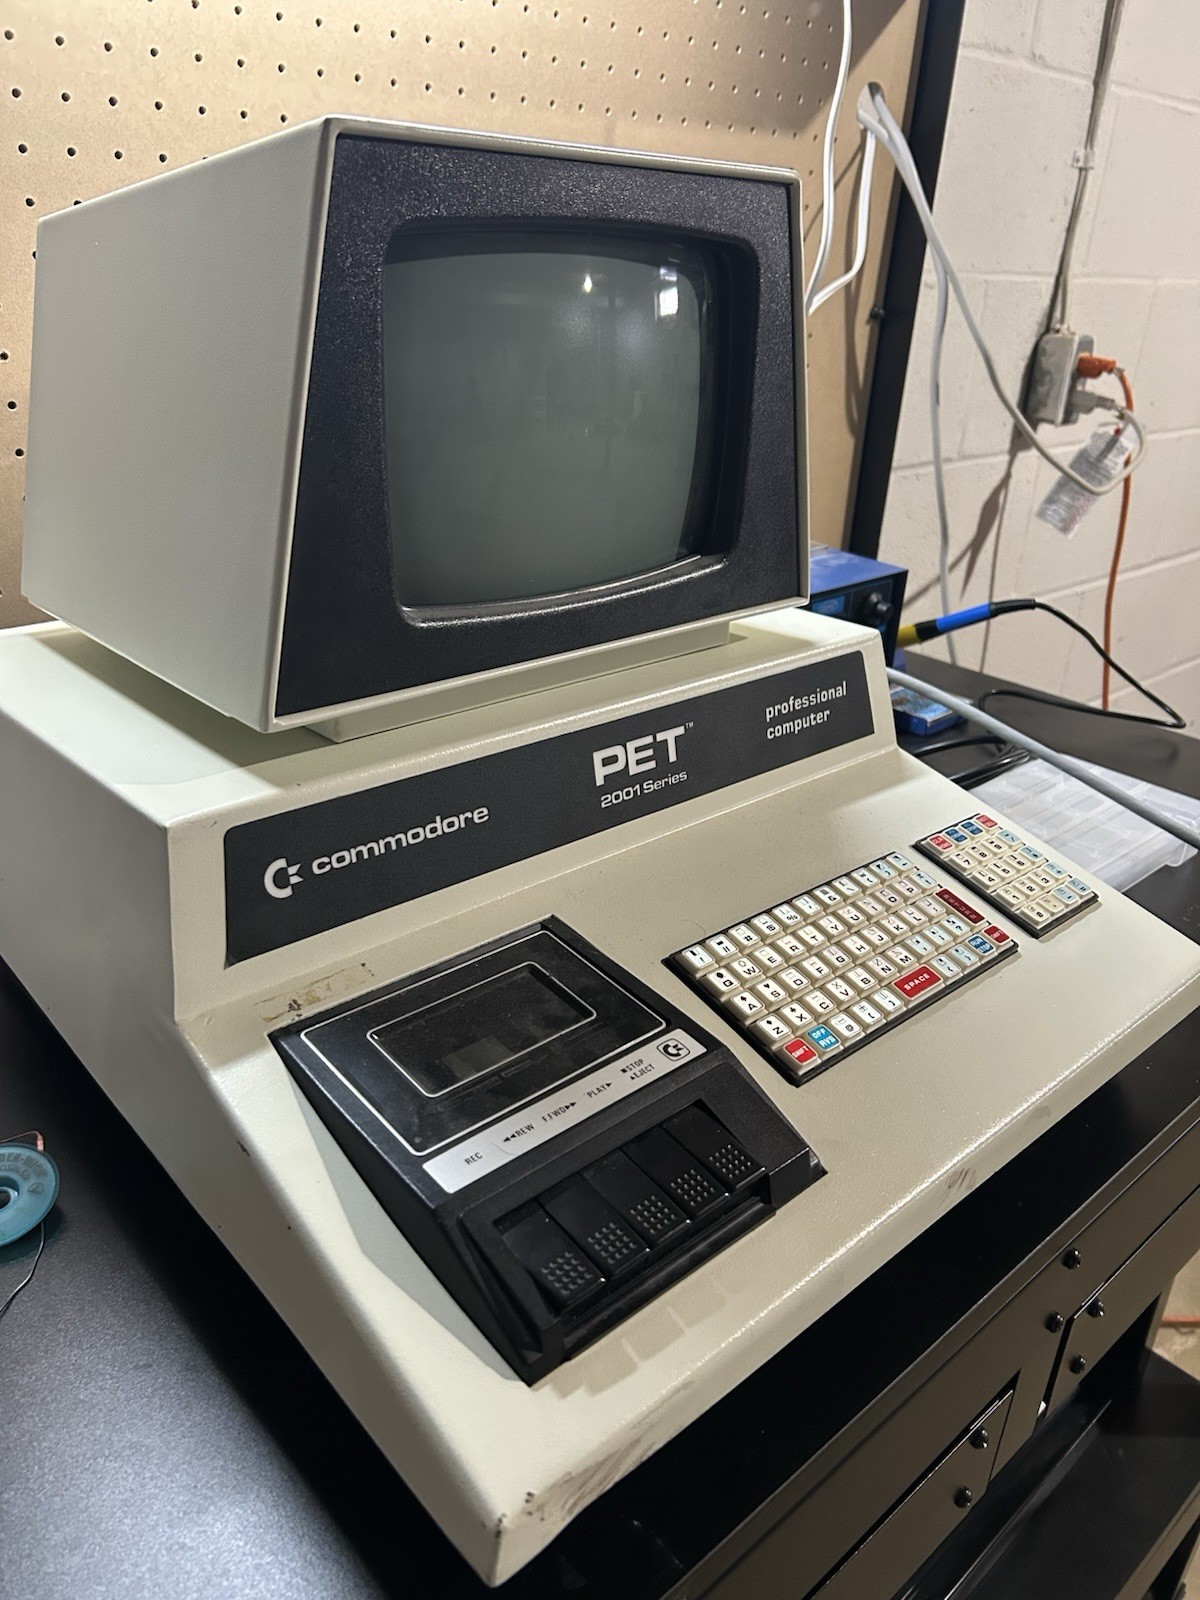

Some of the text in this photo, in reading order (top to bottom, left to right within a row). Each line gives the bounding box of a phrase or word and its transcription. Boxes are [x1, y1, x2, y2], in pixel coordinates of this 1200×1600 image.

[765, 681, 848, 722] professional
[766, 709, 831, 739] computer
[592, 725, 686, 787] PET
[600, 771, 688, 809] 2001 Series
[311, 806, 490, 875] commodore
[903, 972, 931, 991] SPACE
[811, 1027, 827, 1039] OFF
[818, 1035, 836, 1048] RVS
[626, 1058, 646, 1072] STOP
[634, 1064, 656, 1080] EJECT
[586, 1084, 607, 1099] PLAY
[515, 1123, 536, 1138] REW
[464, 1151, 484, 1166] REC
